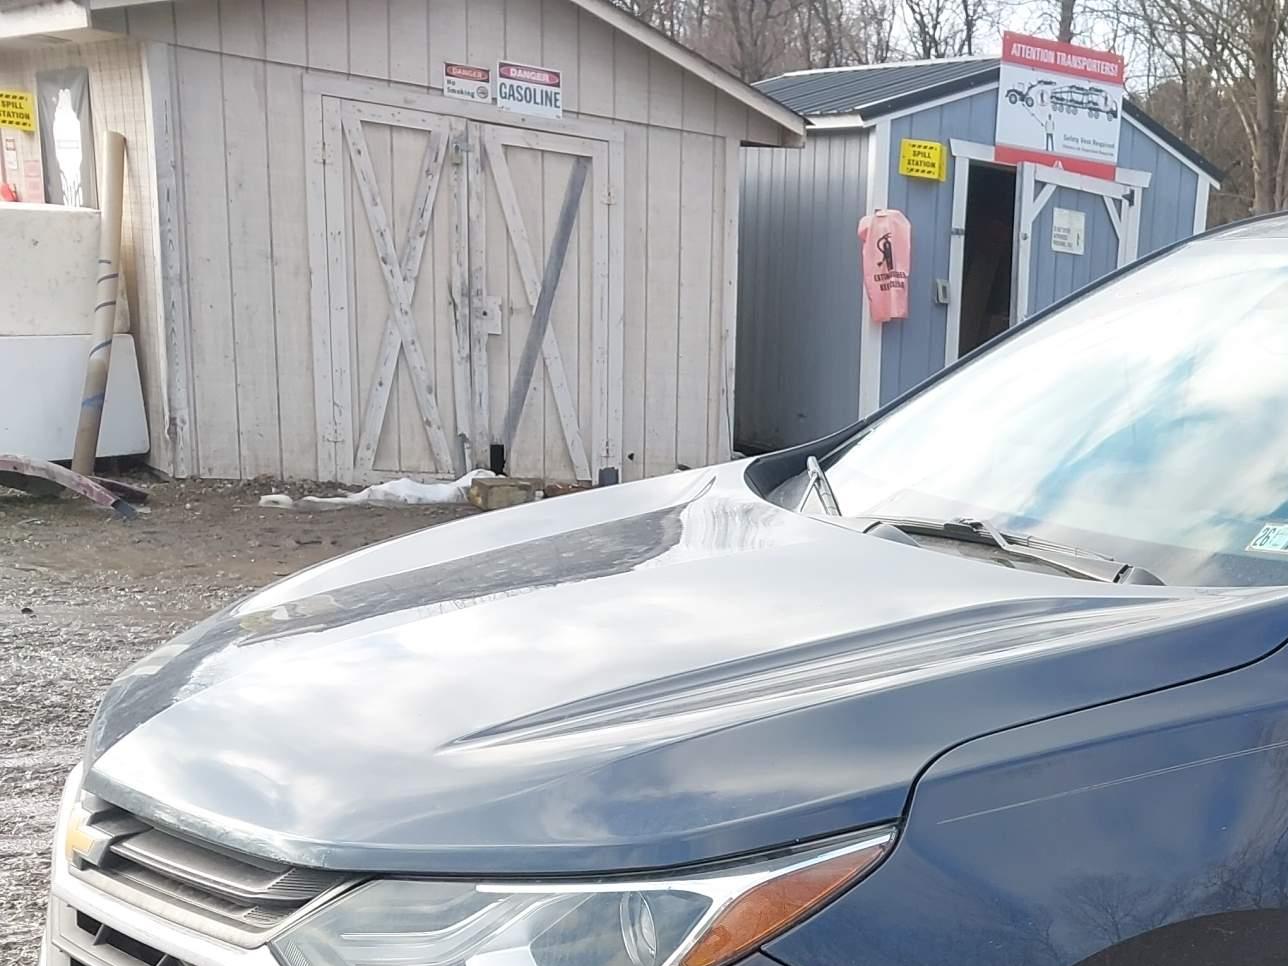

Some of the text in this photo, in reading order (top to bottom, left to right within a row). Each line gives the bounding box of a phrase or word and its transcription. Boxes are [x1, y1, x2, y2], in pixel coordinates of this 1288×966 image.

[1011, 43, 1118, 76] ATTENTION TRANSPORTERS!
[509, 67, 549, 83] DANGER
[446, 86, 475, 98] Smoking
[499, 82, 561, 109] GASOLINE
[1, 100, 24, 110] SPILL
[912, 150, 931, 159] SPILL
[907, 158, 936, 169] STATION
